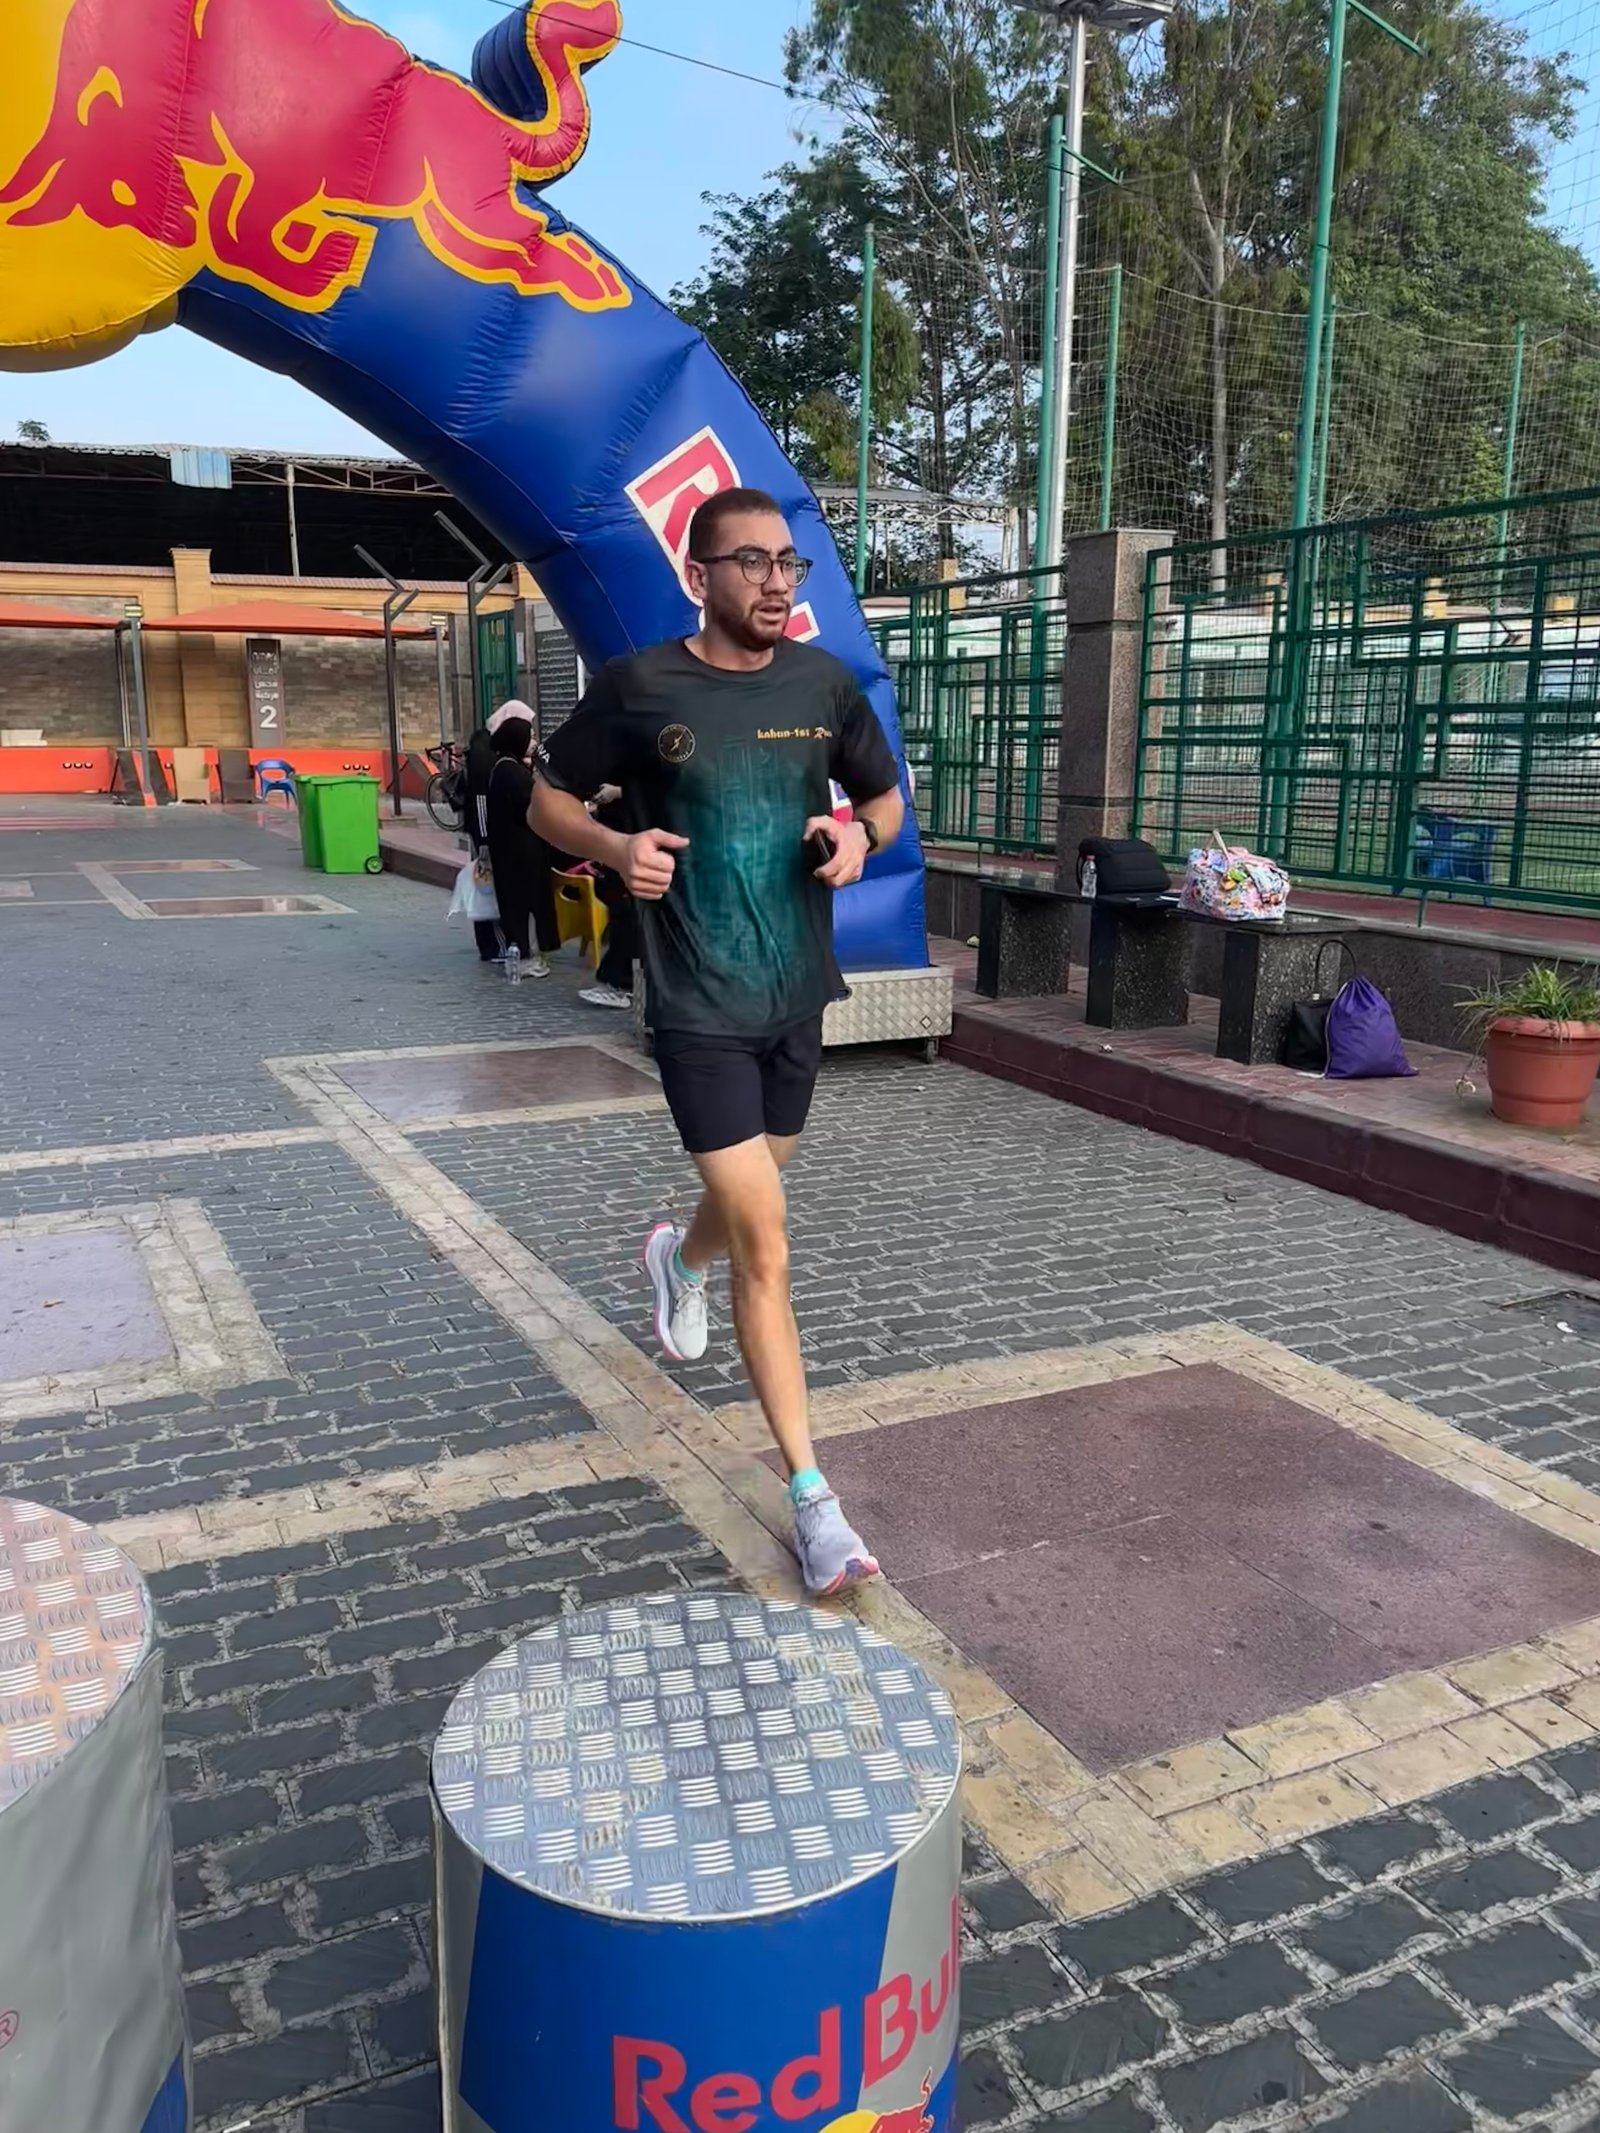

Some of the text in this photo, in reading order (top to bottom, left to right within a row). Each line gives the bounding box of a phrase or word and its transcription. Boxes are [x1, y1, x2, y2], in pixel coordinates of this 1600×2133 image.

[260, 705, 278, 728] 2
[612, 1892, 959, 2133] Red Bul
